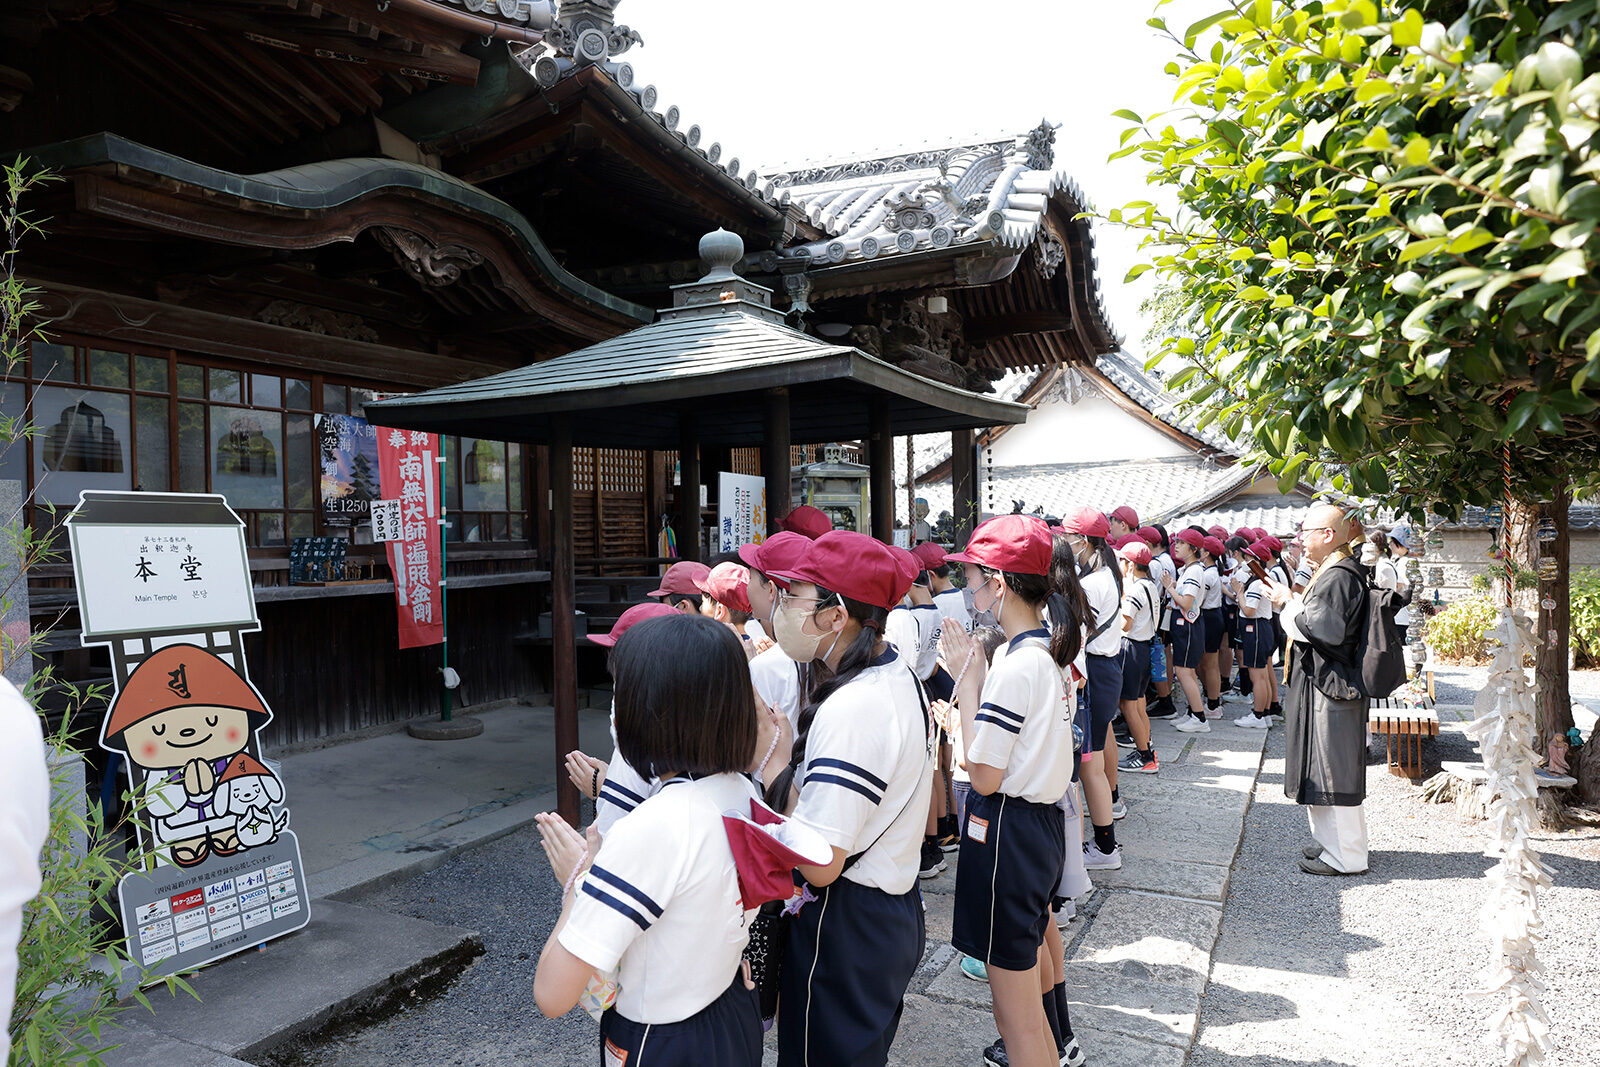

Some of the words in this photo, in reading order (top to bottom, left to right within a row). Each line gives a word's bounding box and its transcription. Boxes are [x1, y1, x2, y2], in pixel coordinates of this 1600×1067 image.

[324, 416, 376, 438] 弘法大師
[324, 436, 352, 452] 空海
[388, 429, 429, 449] 奉納
[341, 500, 368, 512] 1250
[398, 451, 432, 624] 南無大師遍照金剛
[134, 555, 202, 583] 本堂
[208, 880, 232, 896] Asahi
